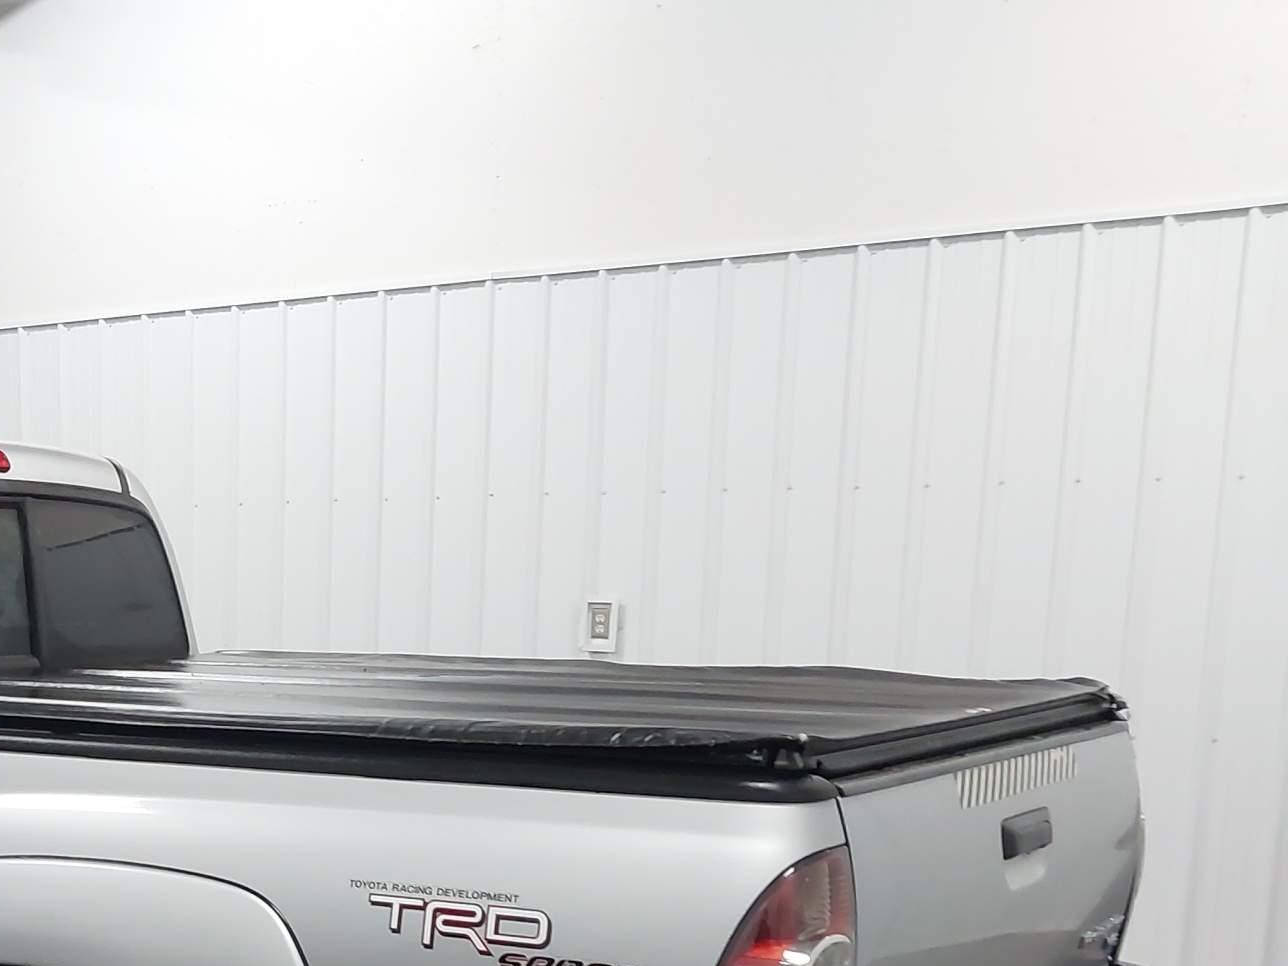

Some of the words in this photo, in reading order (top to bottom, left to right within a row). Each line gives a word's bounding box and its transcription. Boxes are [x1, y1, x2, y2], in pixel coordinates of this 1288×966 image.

[350, 879, 388, 891] TOYOTA
[392, 883, 432, 896] RACING
[436, 887, 520, 903] DEVELOPMENT
[368, 893, 552, 956] TRD
